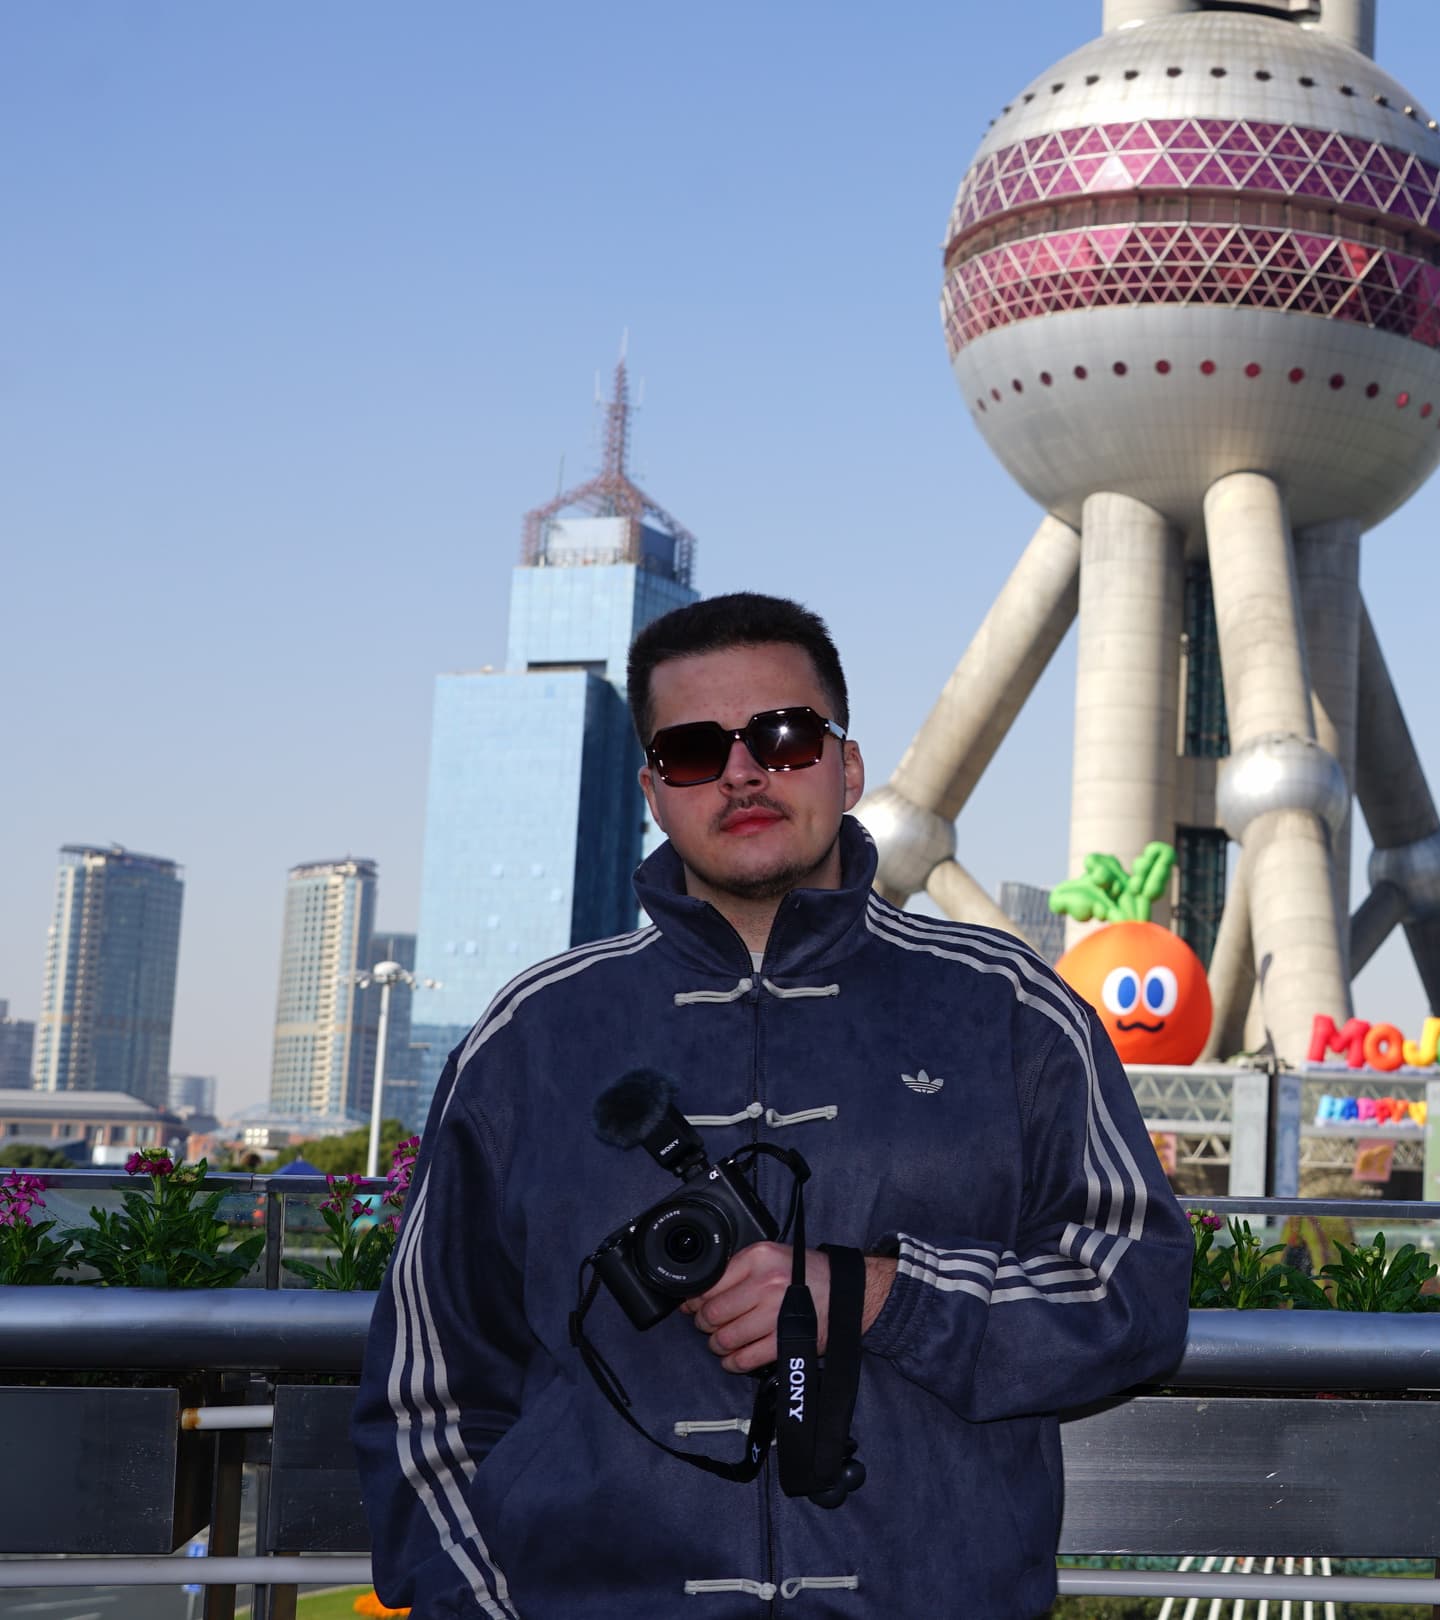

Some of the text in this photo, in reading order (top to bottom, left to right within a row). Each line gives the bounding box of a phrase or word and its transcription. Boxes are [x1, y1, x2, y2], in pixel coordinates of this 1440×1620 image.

[1317, 1094, 1409, 1126] HAPPY
[660, 1138, 680, 1156] SONY
[789, 1357, 805, 1422] SONY
